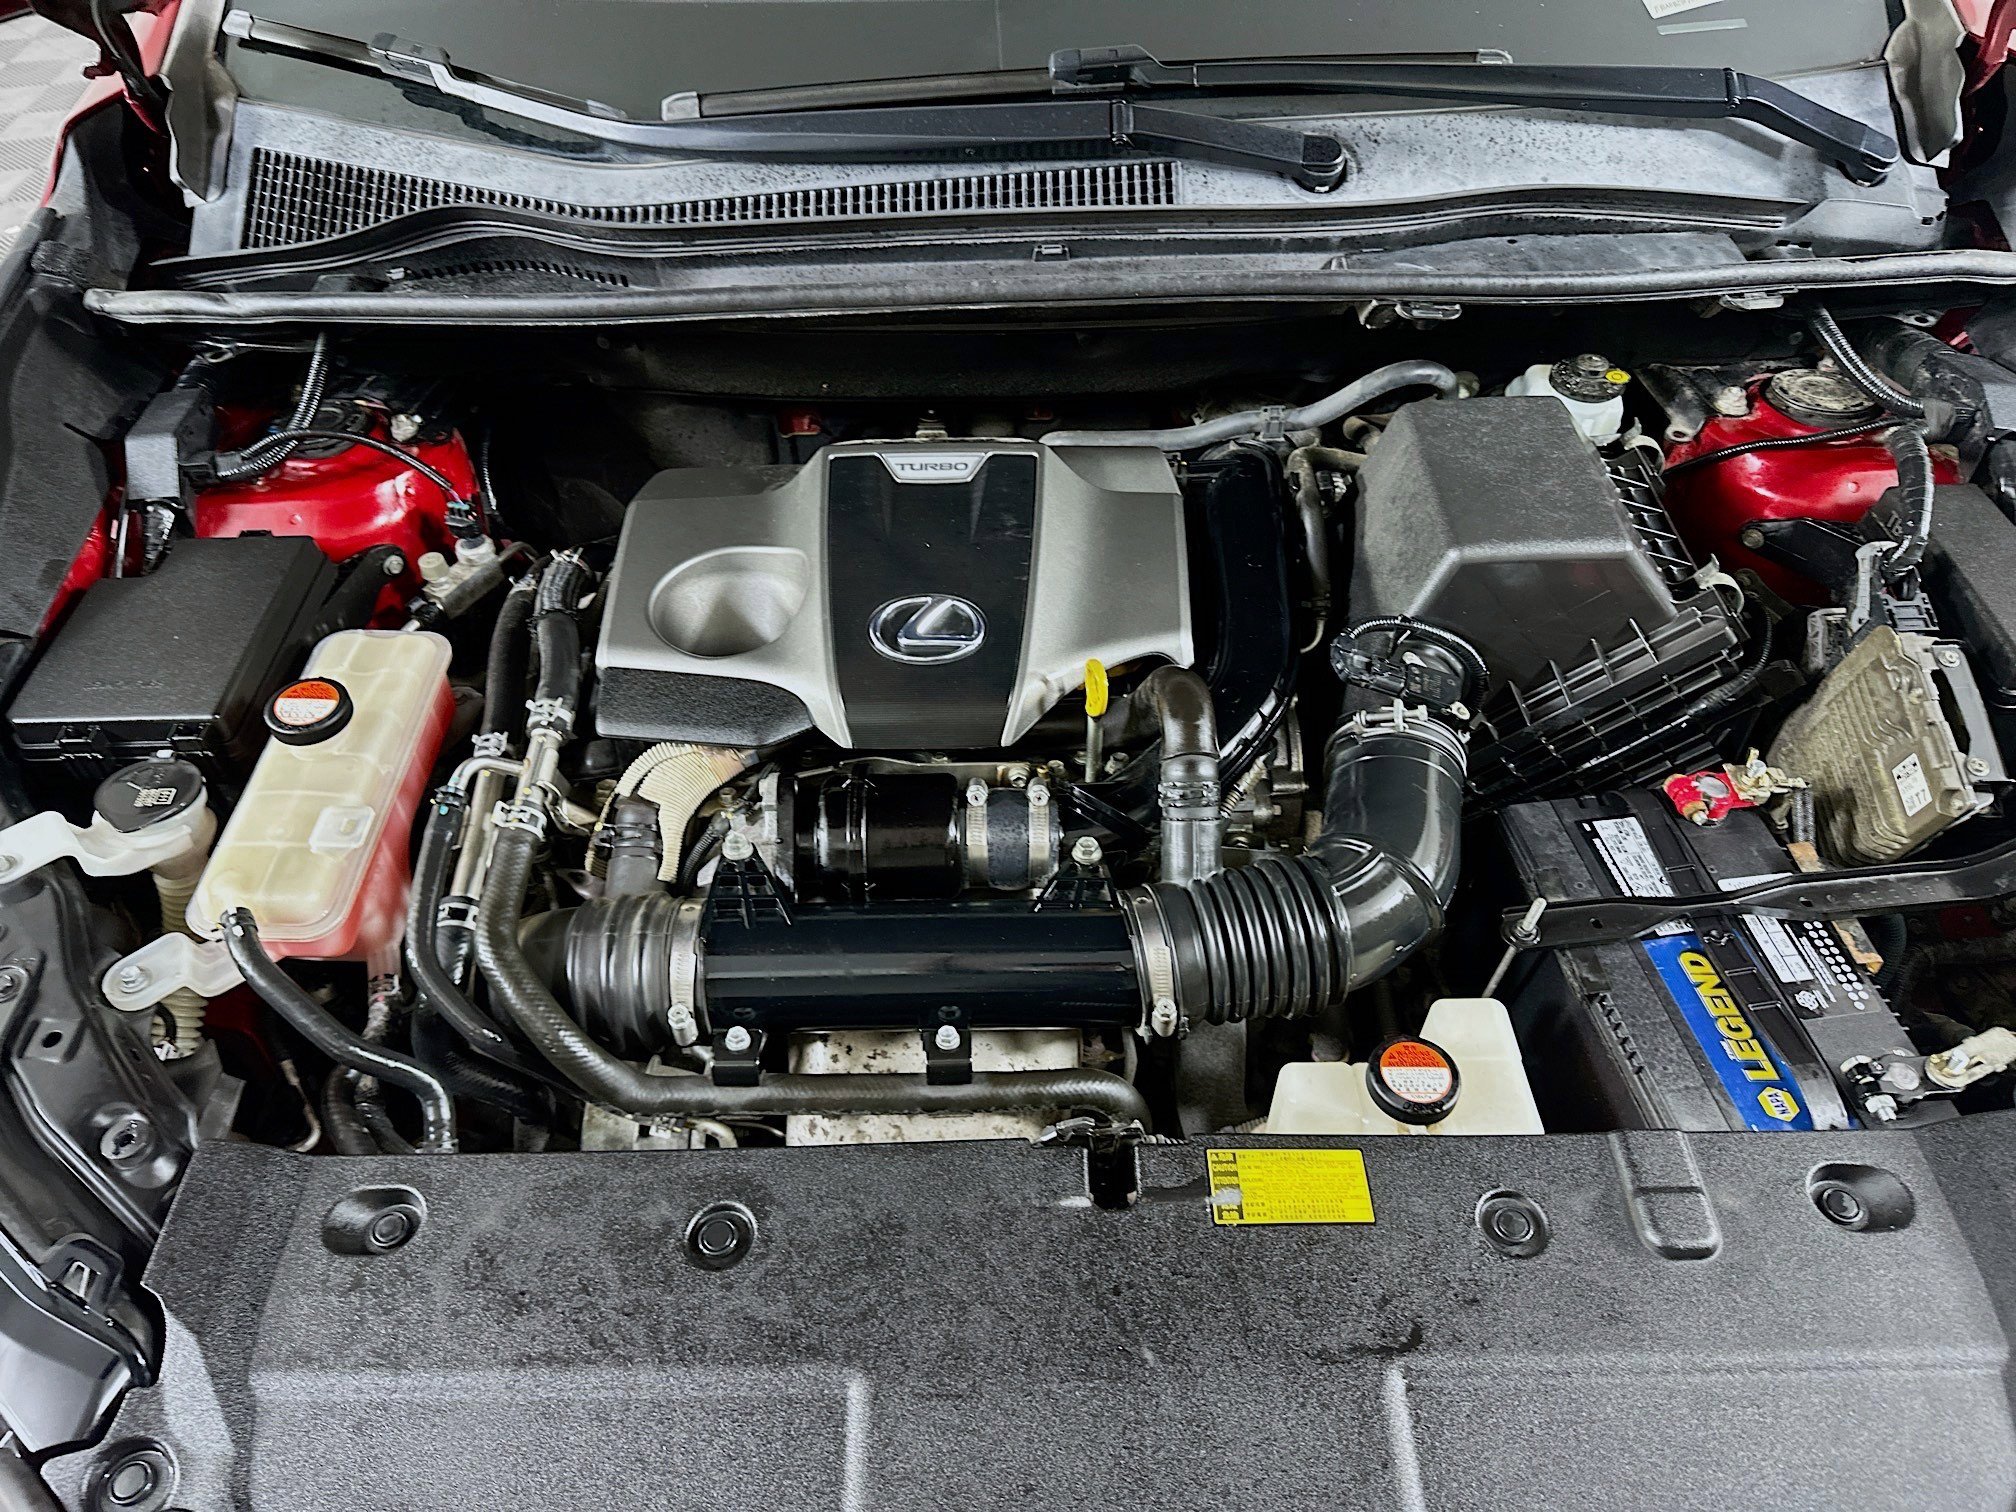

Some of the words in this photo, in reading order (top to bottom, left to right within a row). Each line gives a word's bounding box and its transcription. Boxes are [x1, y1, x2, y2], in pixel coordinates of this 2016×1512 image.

[894, 462, 969, 471] TURBO
[1677, 952, 1781, 1082] LEGEND
[1767, 1091, 1790, 1115] NAPA
